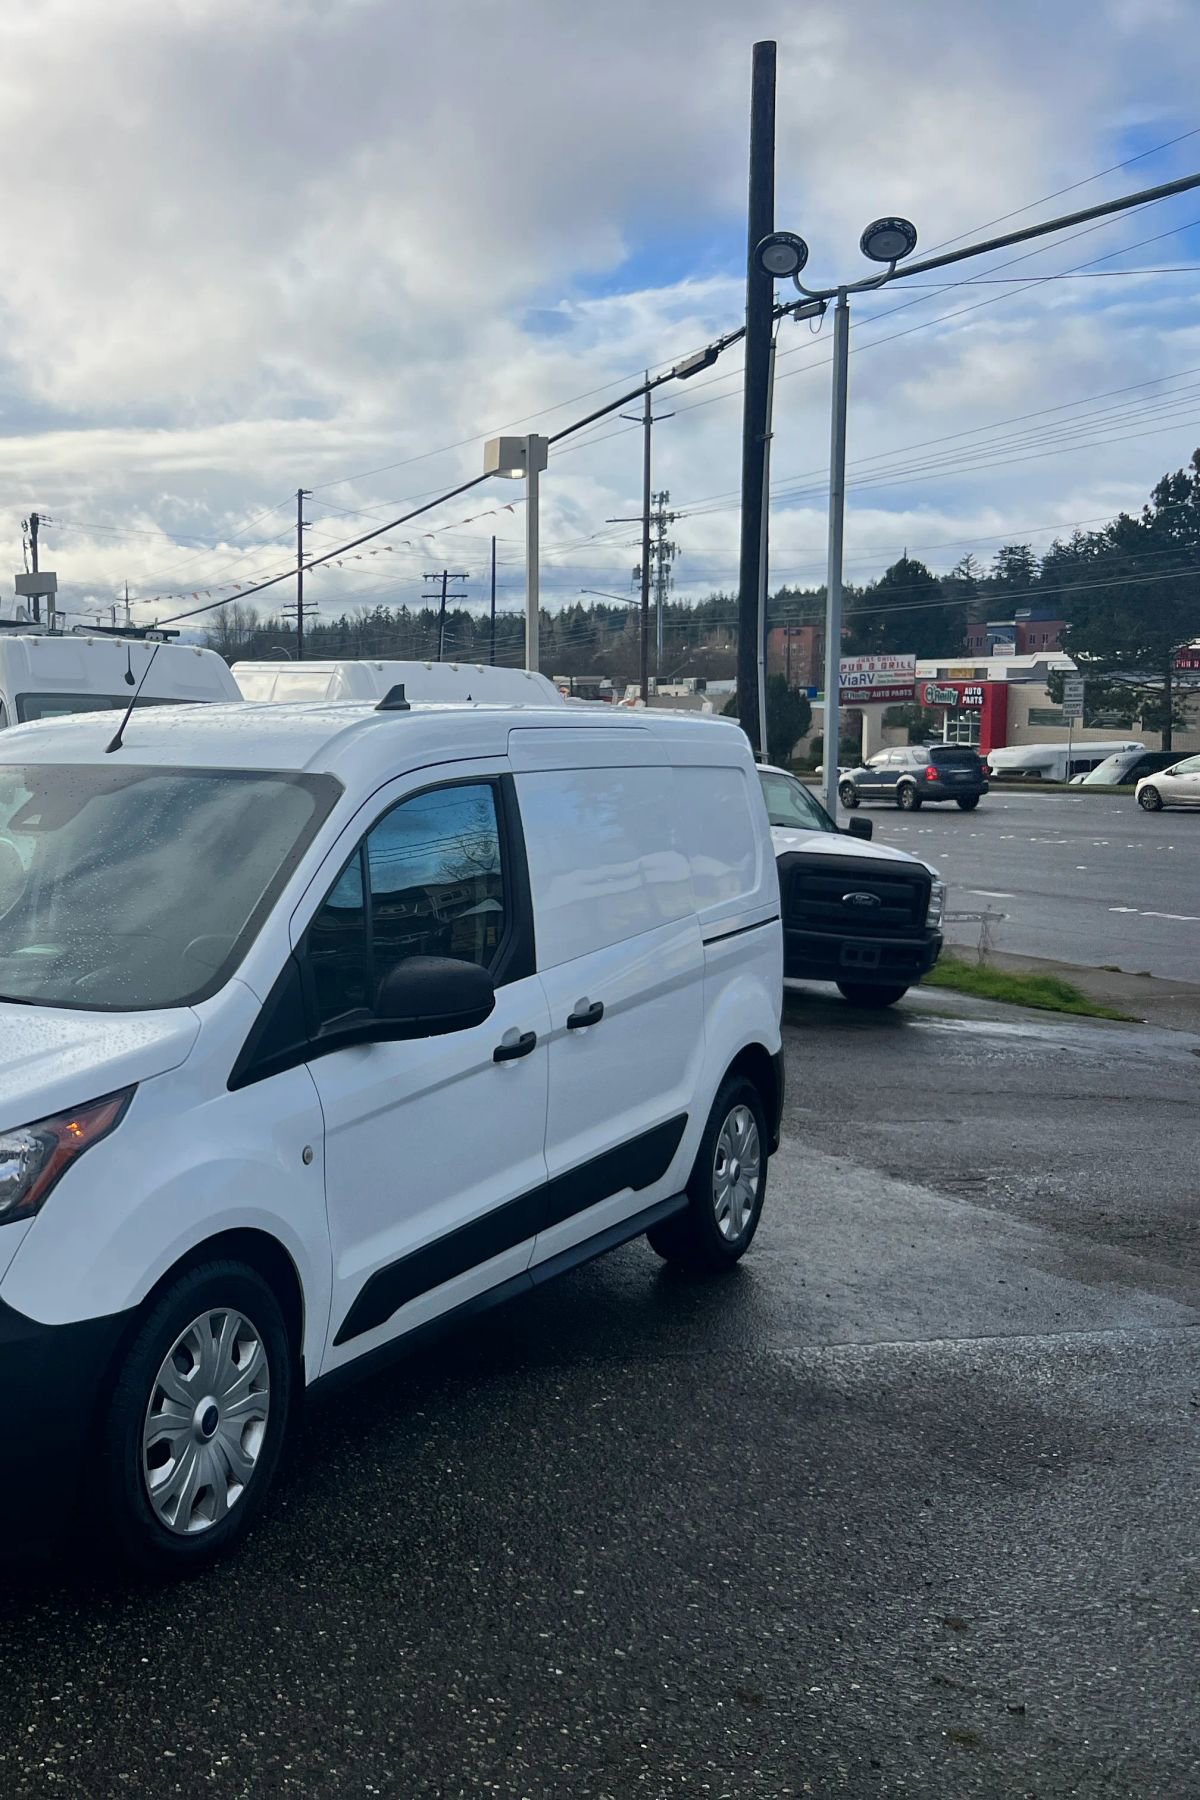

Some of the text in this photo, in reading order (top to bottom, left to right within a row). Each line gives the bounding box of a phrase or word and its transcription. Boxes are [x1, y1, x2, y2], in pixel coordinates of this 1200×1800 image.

[839, 673, 875, 686] ViaRV
[872, 690, 890, 698] AUTO
[924, 684, 982, 706] O'Reilly AUTO
[962, 696, 983, 704] PARTS
